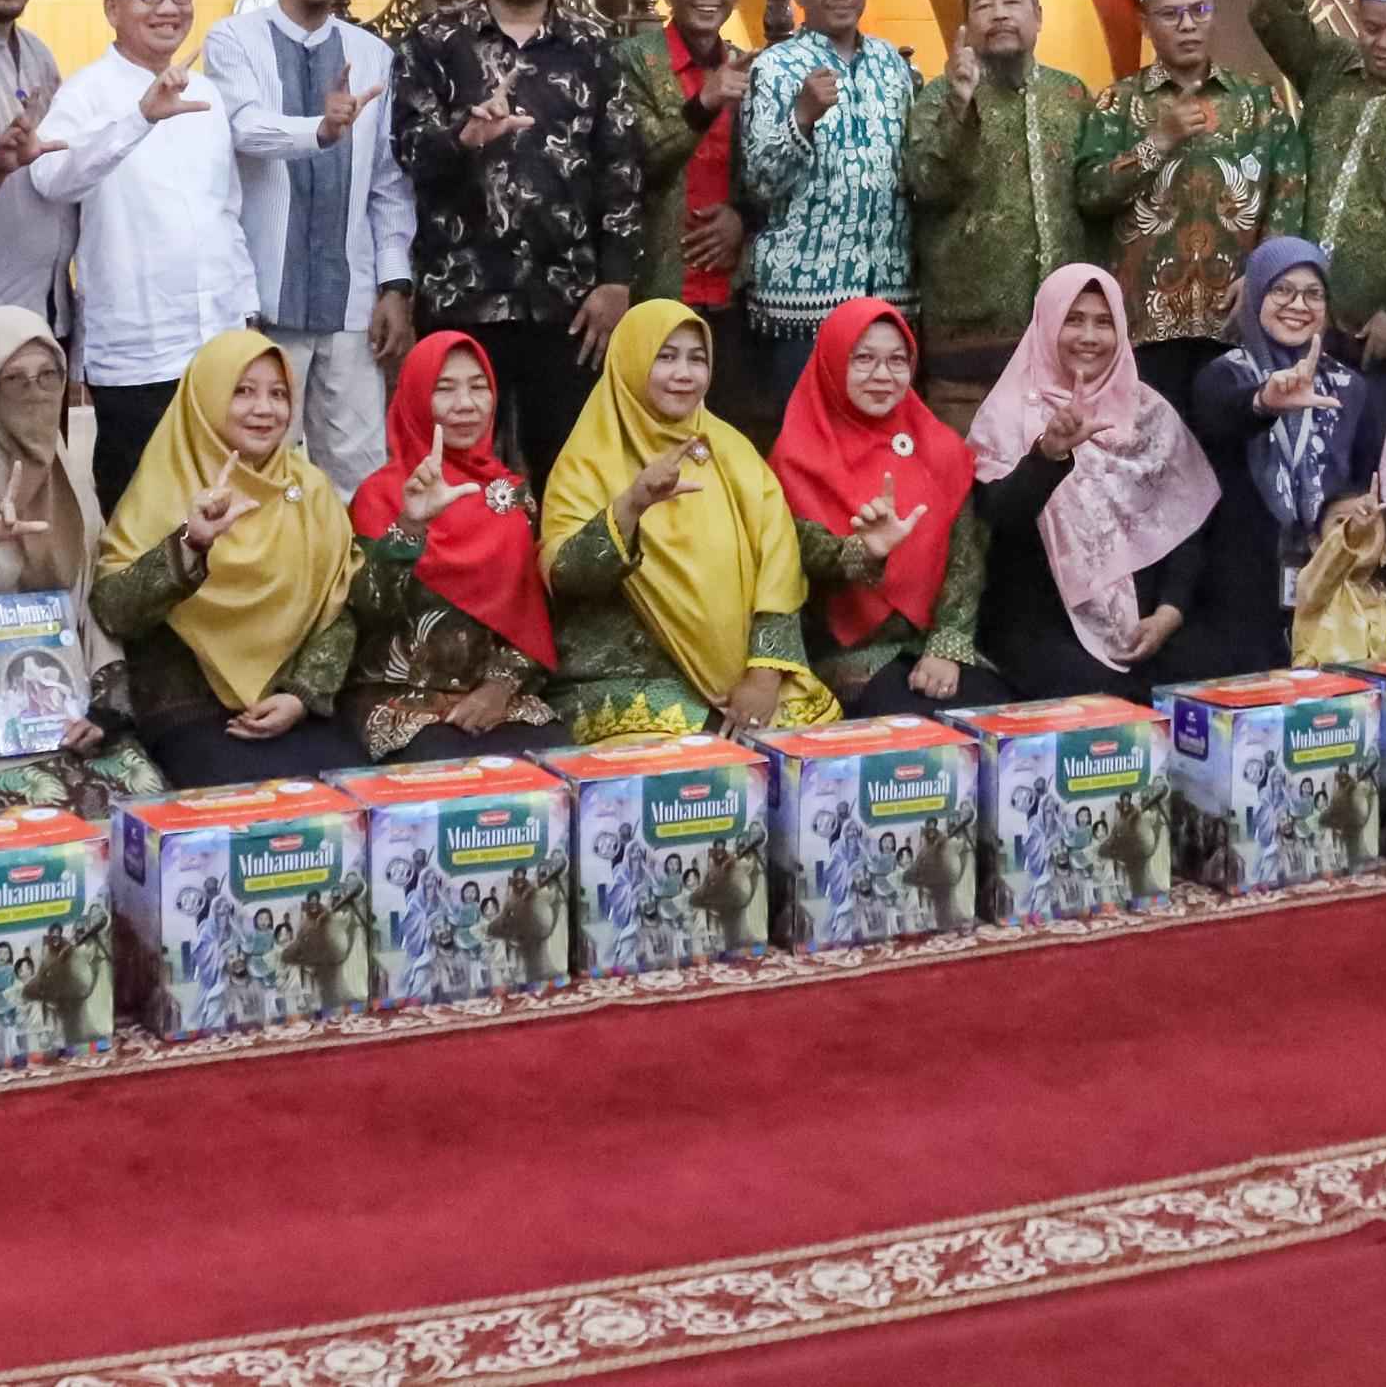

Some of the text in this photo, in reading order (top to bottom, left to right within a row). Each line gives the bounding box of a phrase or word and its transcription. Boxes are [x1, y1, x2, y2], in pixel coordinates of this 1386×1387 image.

[1064, 747, 1144, 777] Muhammad
[868, 771, 950, 801] Muhammad
[651, 790, 739, 822] Muhammad
[447, 818, 540, 849] Muhammad
[239, 841, 335, 876] Muhammad
